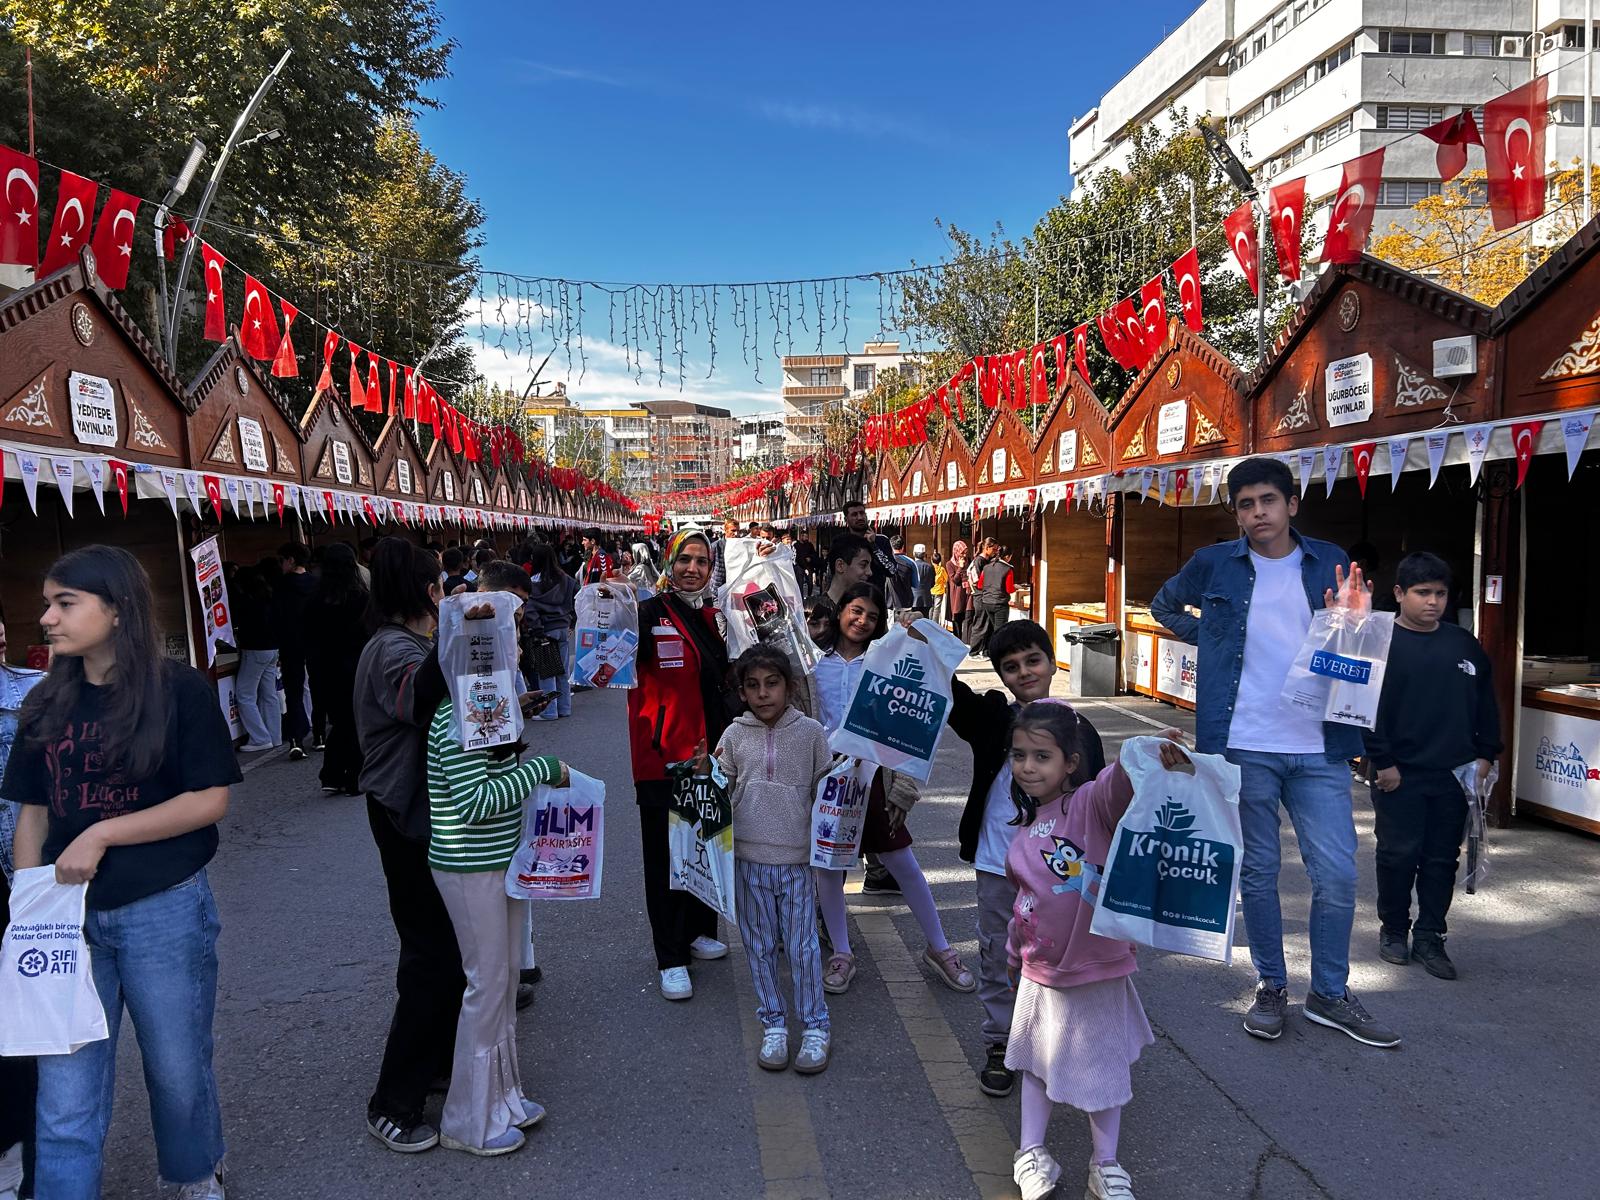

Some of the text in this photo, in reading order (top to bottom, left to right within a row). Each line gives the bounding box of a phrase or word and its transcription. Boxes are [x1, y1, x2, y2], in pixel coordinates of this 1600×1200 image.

[1328, 381, 1370, 402] UĞURBÖCEĞİ
[76, 402, 112, 421] YEDİTEPE
[1331, 400, 1366, 416] YAYINLARI
[76, 419, 115, 437] YAYINLARI
[1312, 655, 1370, 679] EVEREST
[867, 675, 936, 712] Kronik
[887, 699, 933, 725] Çocuk
[1536, 754, 1589, 782] BATMAN
[822, 775, 867, 808] BİLİM
[1541, 773, 1583, 789] BELEDİYESİ
[1129, 833, 1219, 868] Kronik
[1157, 860, 1218, 885] Çocuk
[36, 932, 53, 940] Geri
